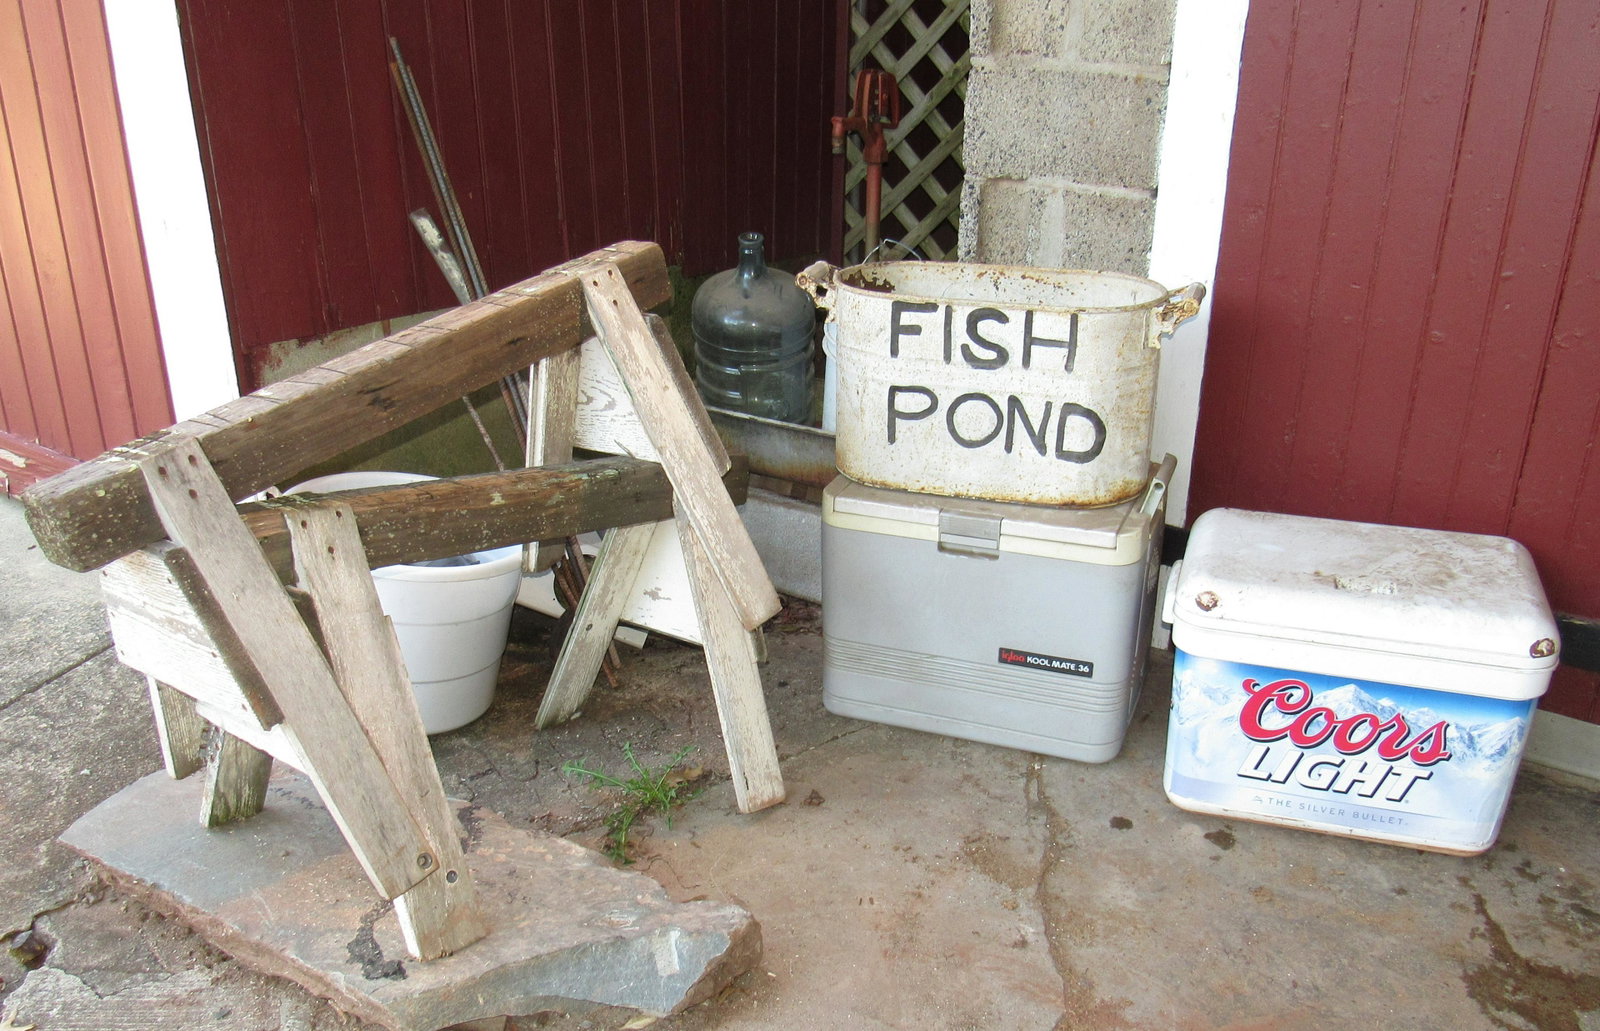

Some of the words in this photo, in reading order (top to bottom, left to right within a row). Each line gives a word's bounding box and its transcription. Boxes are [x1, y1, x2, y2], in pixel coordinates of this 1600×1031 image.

[890, 300, 1078, 373] FISH
[887, 385, 1107, 464] POND
[1001, 649, 1025, 662] igloo
[1026, 655, 1051, 667] KOOL
[1051, 660, 1076, 671] MATE
[1077, 664, 1090, 673] 36
[1239, 678, 1452, 766] Coors
[1237, 744, 1434, 803] LIGHT
[1268, 797, 1292, 808] THE
[1298, 802, 1345, 817] SILVER
